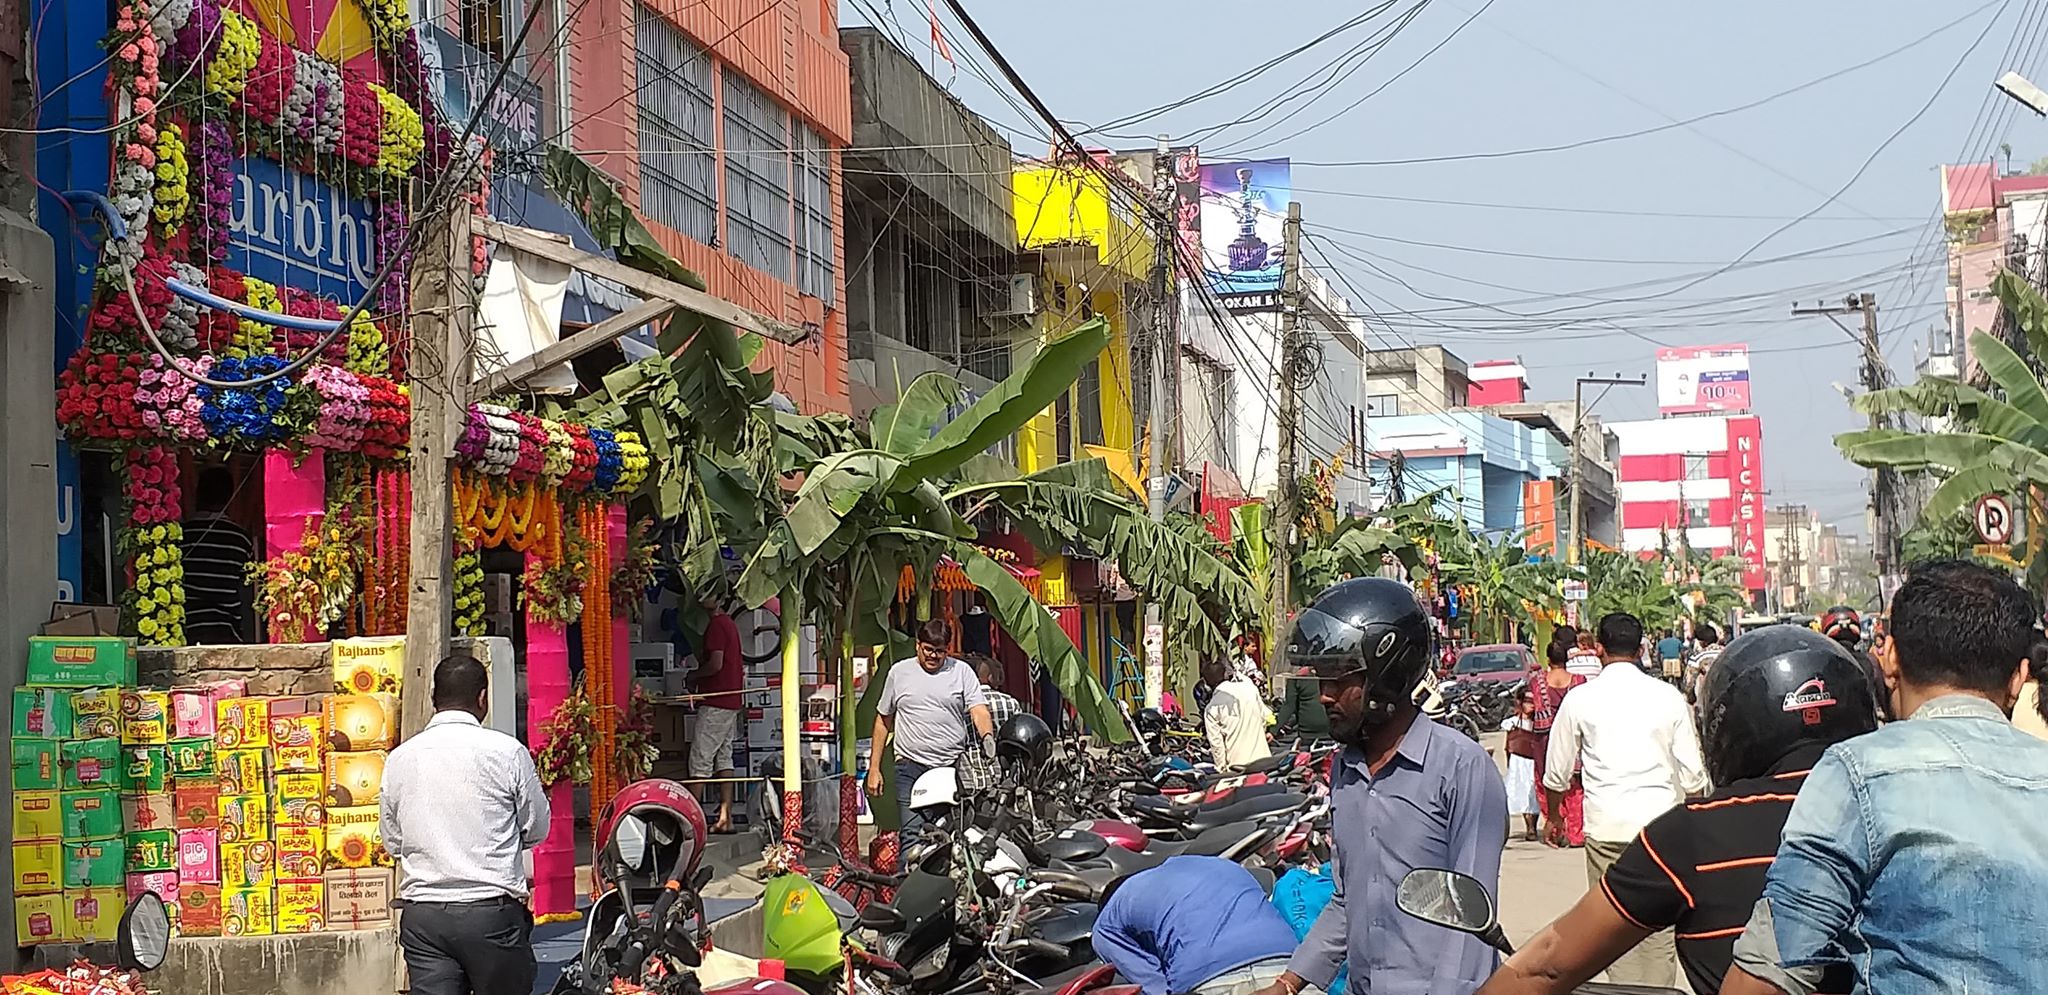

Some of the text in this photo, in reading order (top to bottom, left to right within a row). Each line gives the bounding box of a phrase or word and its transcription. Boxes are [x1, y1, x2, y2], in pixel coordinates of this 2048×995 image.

[230, 174, 375, 290] urbhi
[338, 645, 385, 659] Rajhans
[329, 813, 379, 827] Rajhans
[185, 844, 203, 855] BIG
